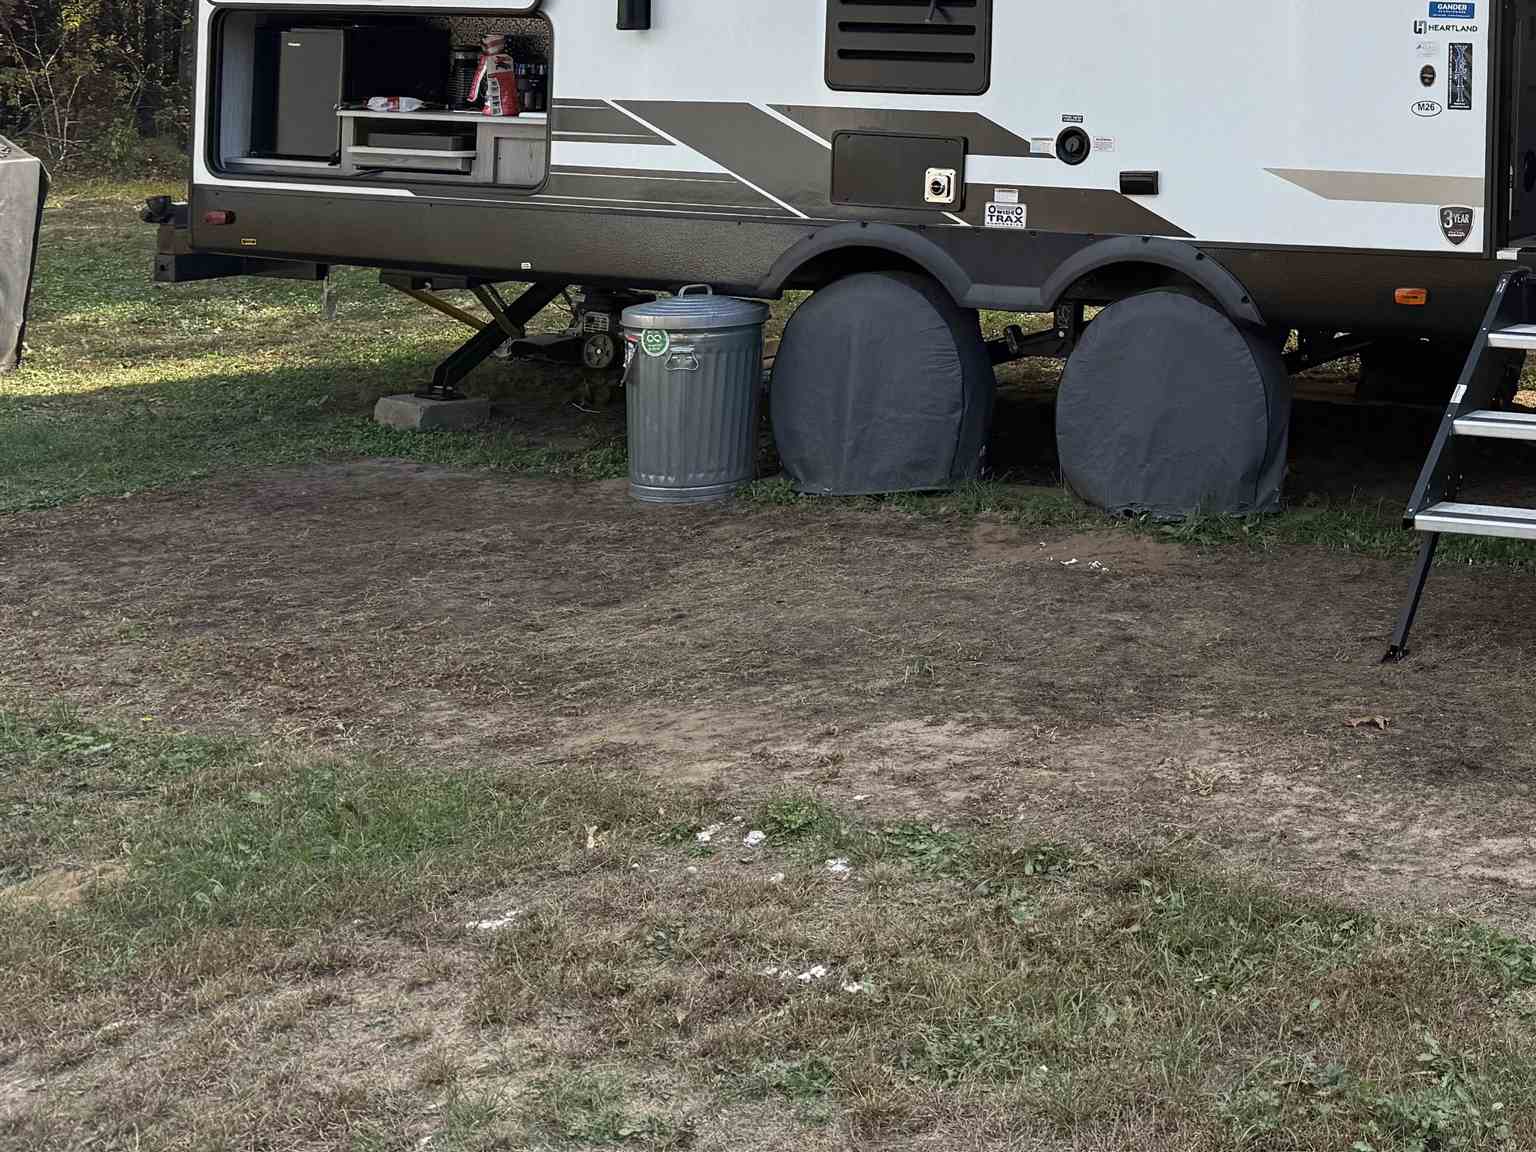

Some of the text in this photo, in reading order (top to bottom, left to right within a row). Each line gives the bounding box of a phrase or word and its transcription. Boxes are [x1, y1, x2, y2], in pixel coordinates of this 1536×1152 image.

[1428, 24, 1478, 32] HEARTLAND
[1417, 102, 1436, 112] M26
[988, 214, 1022, 223] TRAX
[1444, 210, 1469, 227] 3 YEAR
